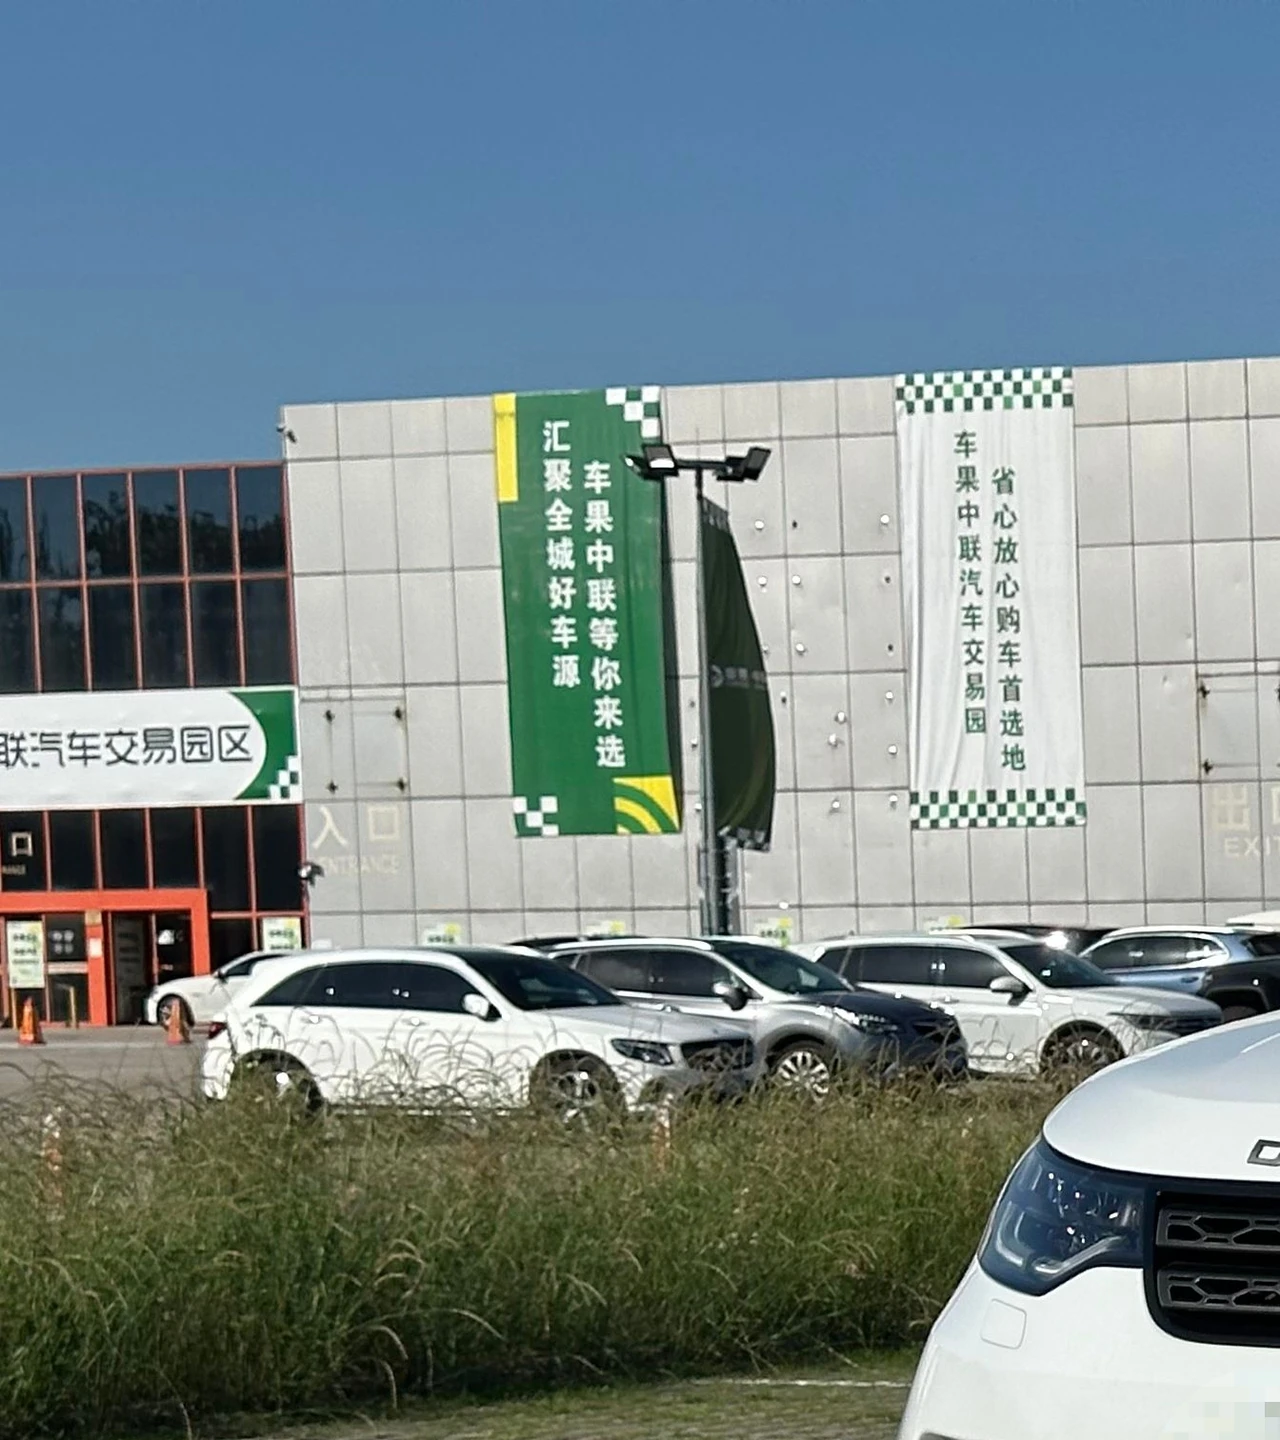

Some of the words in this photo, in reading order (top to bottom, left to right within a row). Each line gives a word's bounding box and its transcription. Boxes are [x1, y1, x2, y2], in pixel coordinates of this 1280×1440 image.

[542, 420, 580, 688] 汇聚全城好车源
[584, 460, 626, 768] 车果中联等你来选
[953, 430, 987, 735] 车果中联汽车交易园
[991, 466, 1026, 772] 省心放心购车首选地
[0, 724, 252, 768] 联汽车交易园区
[312, 802, 402, 849] 入口
